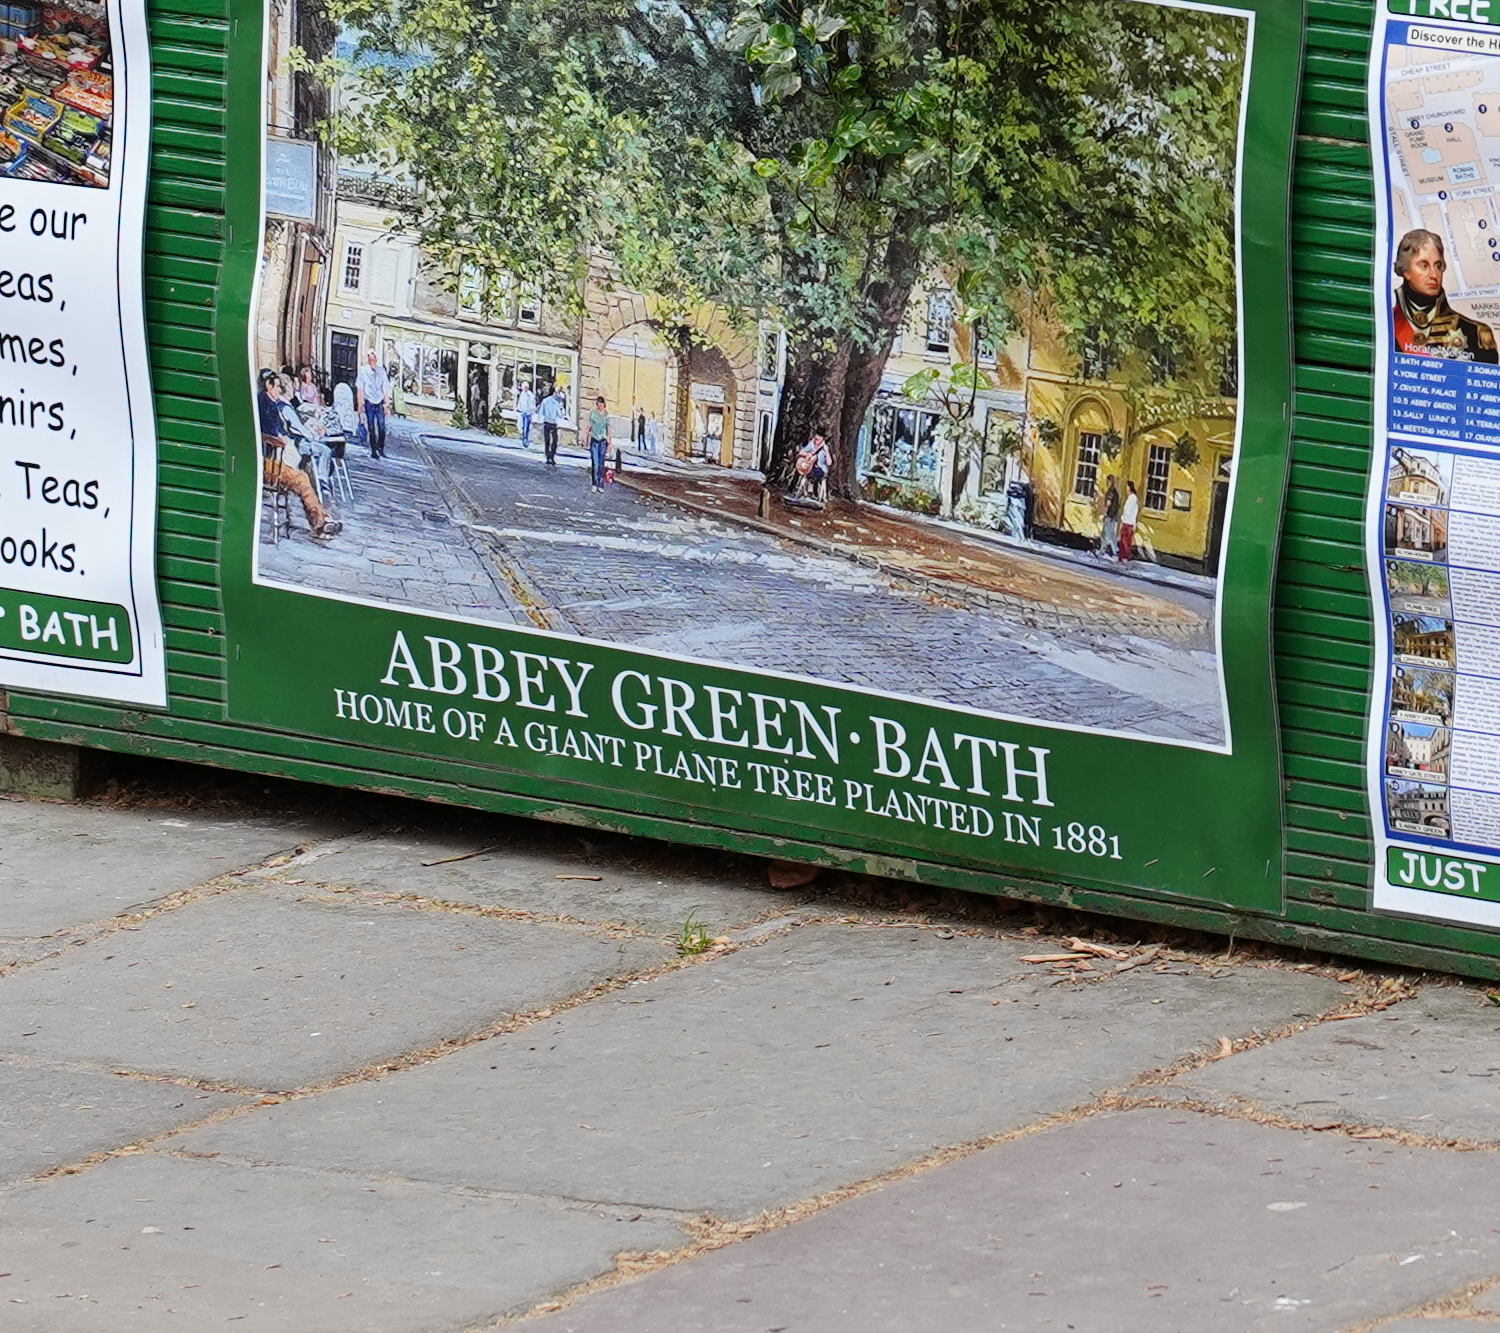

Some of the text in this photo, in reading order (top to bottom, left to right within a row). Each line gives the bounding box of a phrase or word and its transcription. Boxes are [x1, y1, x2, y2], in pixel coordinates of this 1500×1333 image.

[1410, 28, 1464, 47] Discover
[1467, 36, 1484, 49] the
[29, 207, 87, 241] our
[16, 460, 111, 517] Teas,
[20, 605, 118, 651] BATH
[380, 628, 592, 720] ABBEY
[334, 688, 1123, 862] HOME OF A GIANT PLANE TREE PLANTED IN 1881
[1399, 851, 1485, 894] JUST
